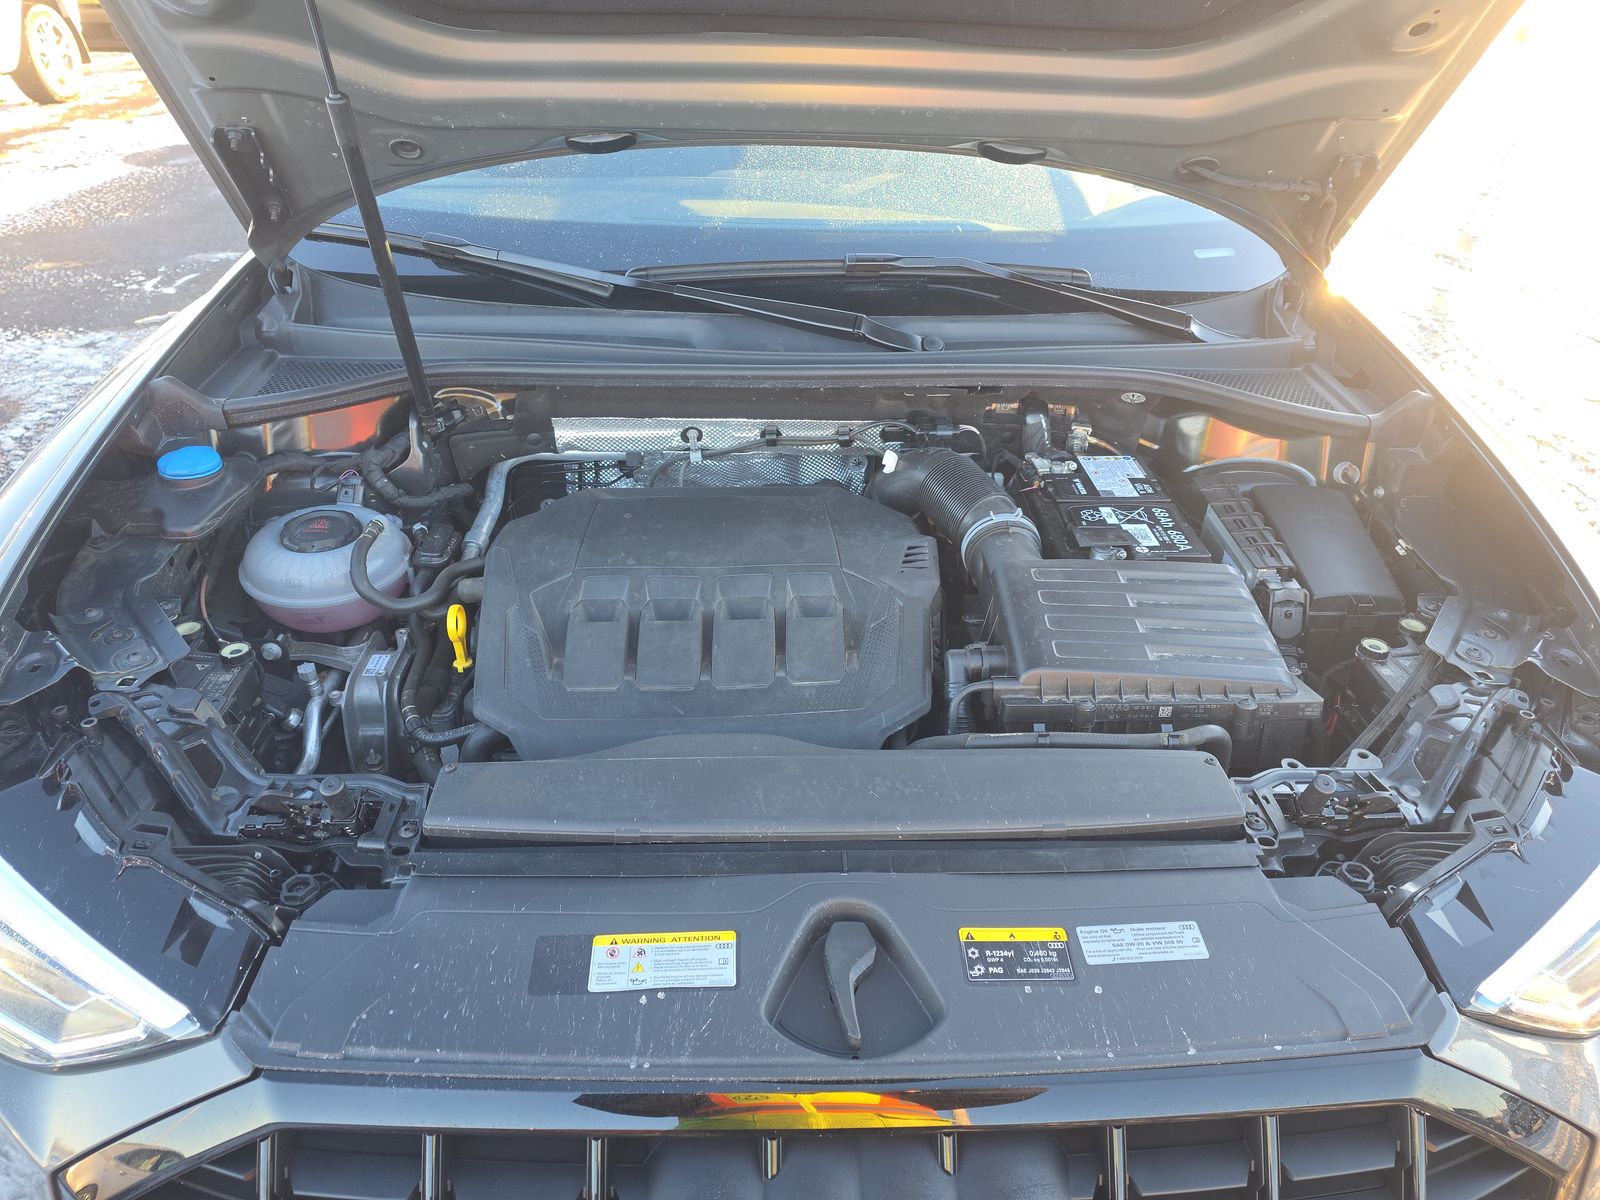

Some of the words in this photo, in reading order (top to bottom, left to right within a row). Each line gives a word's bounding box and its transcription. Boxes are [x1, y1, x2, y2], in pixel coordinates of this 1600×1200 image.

[1151, 507, 1175, 528] 68Ah
[1167, 530, 1192, 550] 680A
[621, 936, 666, 945] WARNING
[670, 934, 721, 943] ATTENTION
[985, 950, 1015, 958] R-1234yf
[1048, 950, 1057, 958] kg
[988, 966, 1004, 974] PAG
